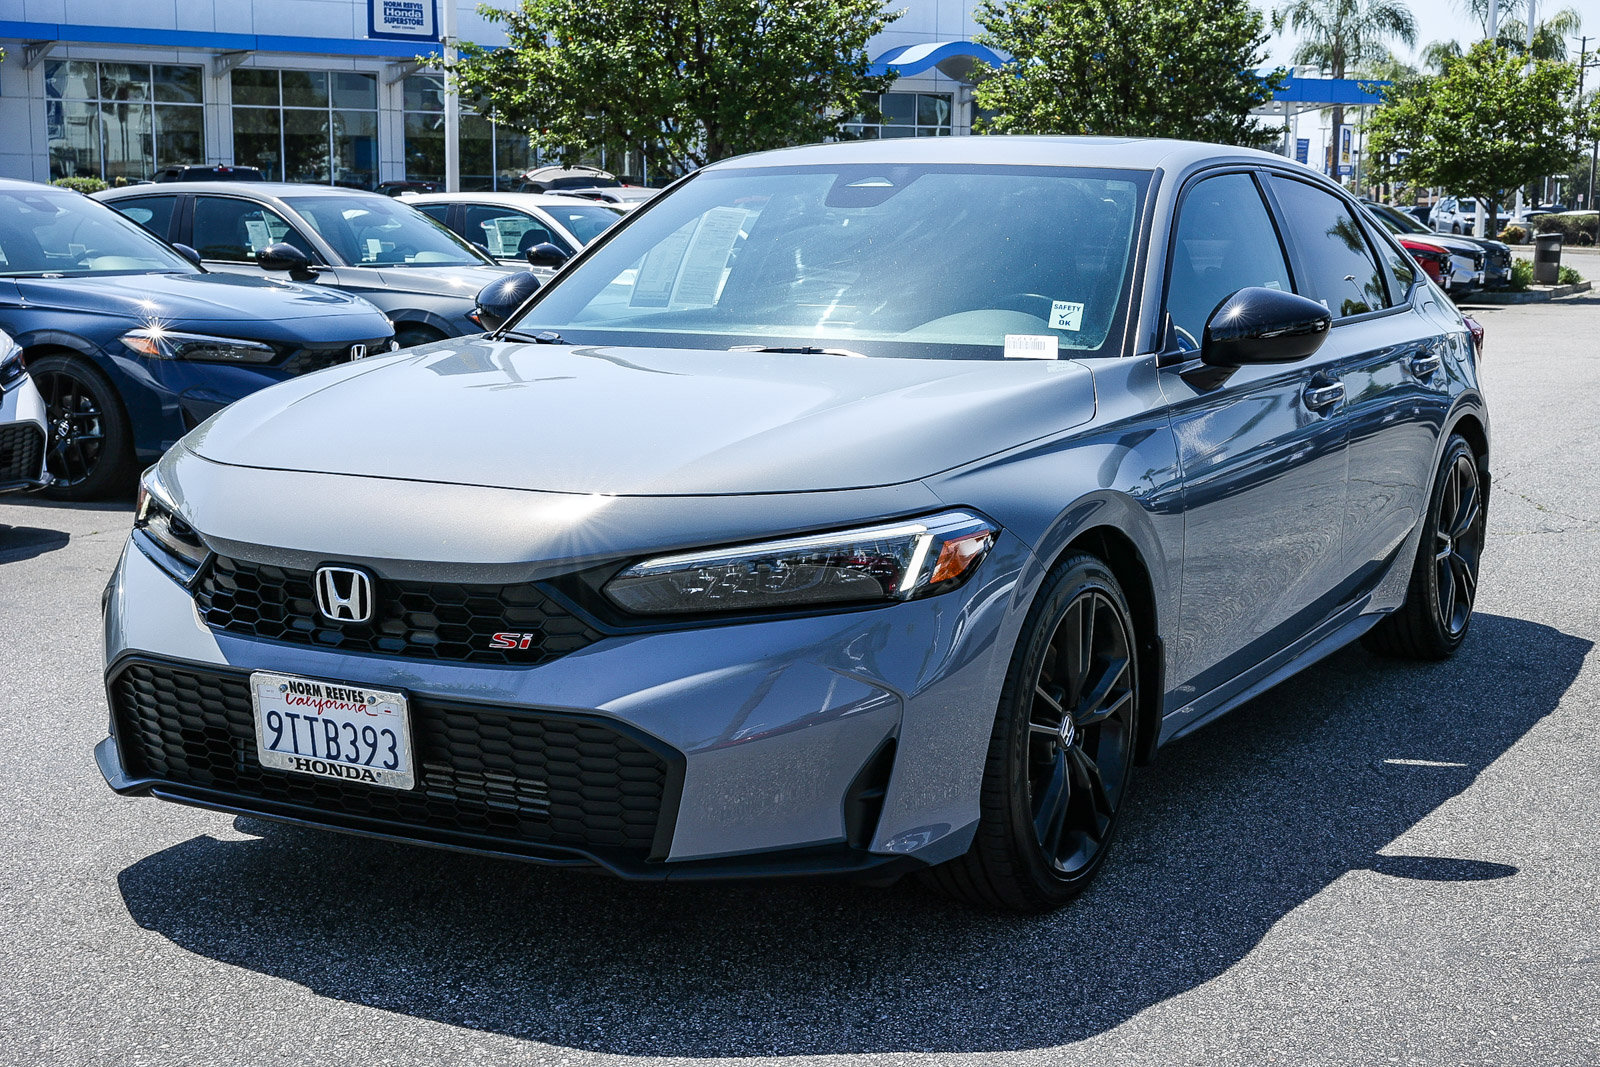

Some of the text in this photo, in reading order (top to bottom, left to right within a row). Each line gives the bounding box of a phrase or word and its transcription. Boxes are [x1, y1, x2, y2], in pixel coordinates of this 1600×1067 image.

[384, 17, 424, 26] SUPERSTORE
[386, 8, 422, 18] Honda
[1053, 304, 1082, 312] SAFETY
[489, 632, 534, 649] Si
[288, 680, 365, 704] NORM REEVES
[266, 710, 399, 771] 9TTB393
[294, 757, 378, 783] HONDA
